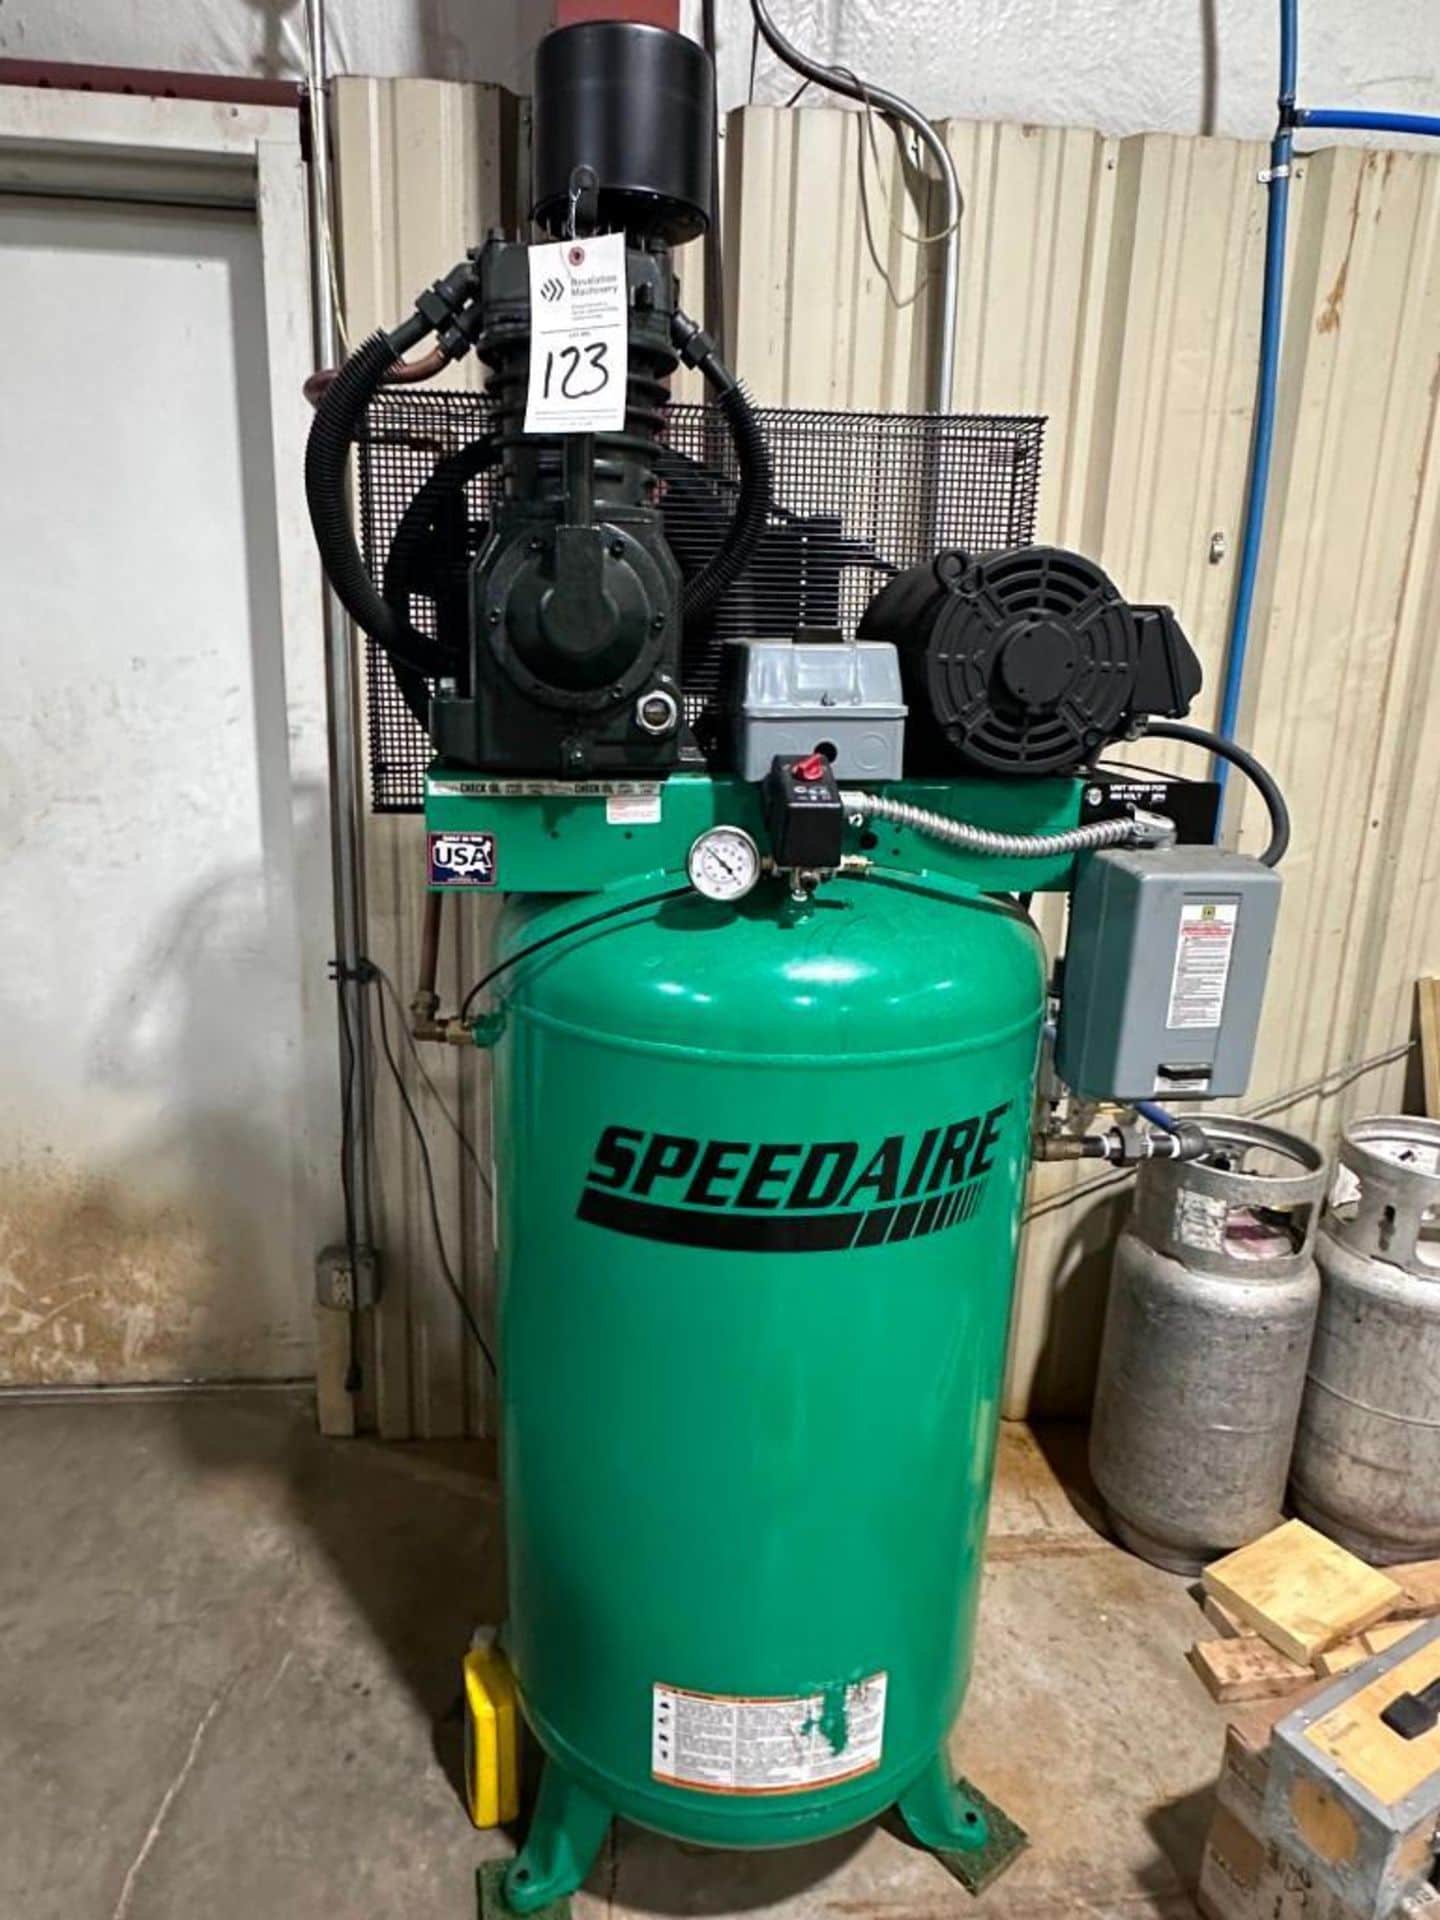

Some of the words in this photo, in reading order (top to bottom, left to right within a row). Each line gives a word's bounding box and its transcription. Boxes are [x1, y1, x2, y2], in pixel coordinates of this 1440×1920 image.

[543, 342, 609, 400] 123
[460, 783, 486, 793] CHECK
[435, 847, 489, 866] USA
[586, 1101, 1012, 1209] SPEEDAIRE
